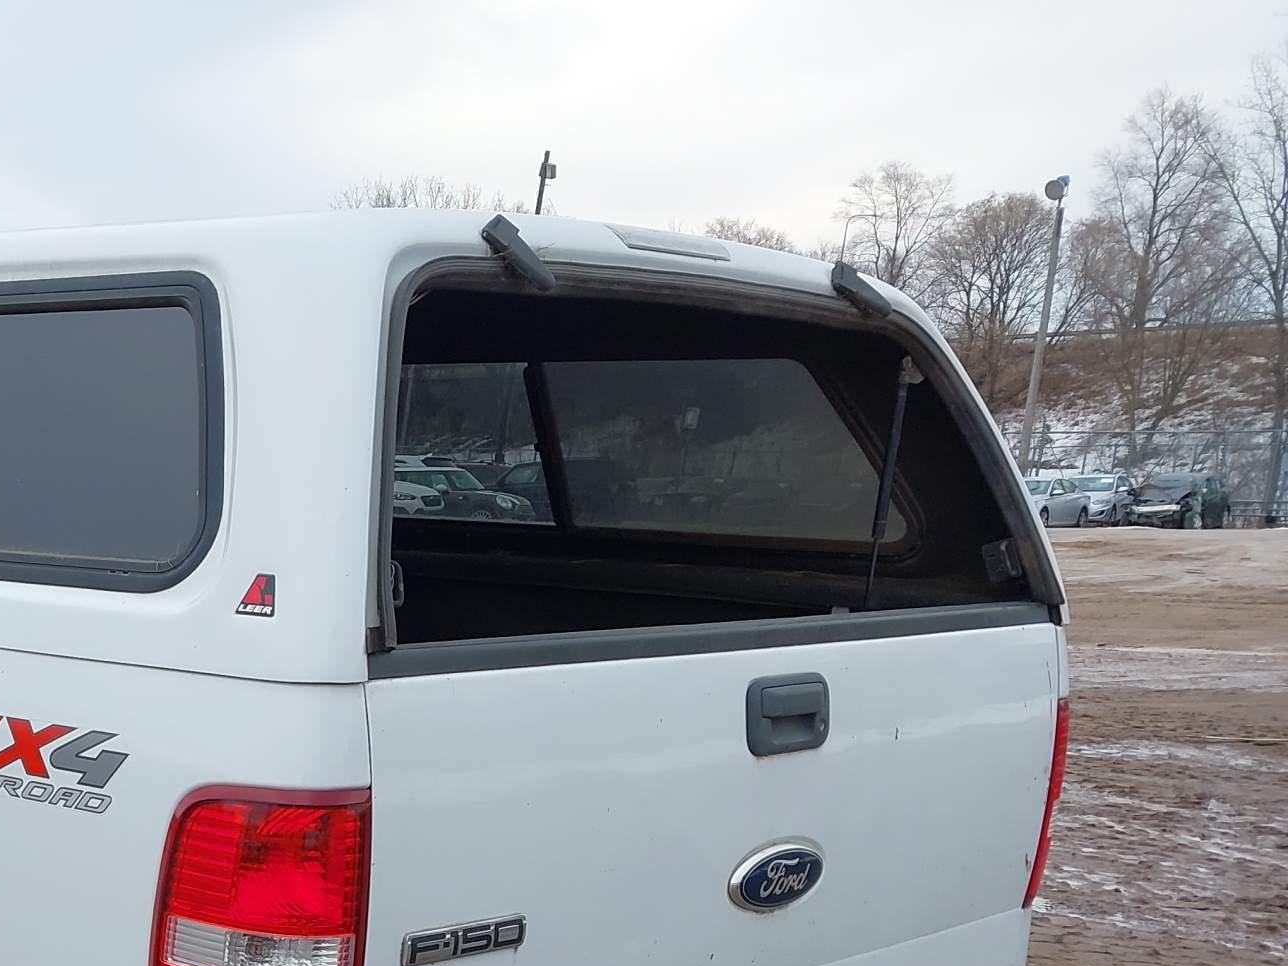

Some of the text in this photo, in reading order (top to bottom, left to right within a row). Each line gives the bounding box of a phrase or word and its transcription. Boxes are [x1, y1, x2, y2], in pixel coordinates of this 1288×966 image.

[238, 604, 273, 615] LEER
[759, 857, 812, 899] Ford
[408, 916, 526, 966] F-150
